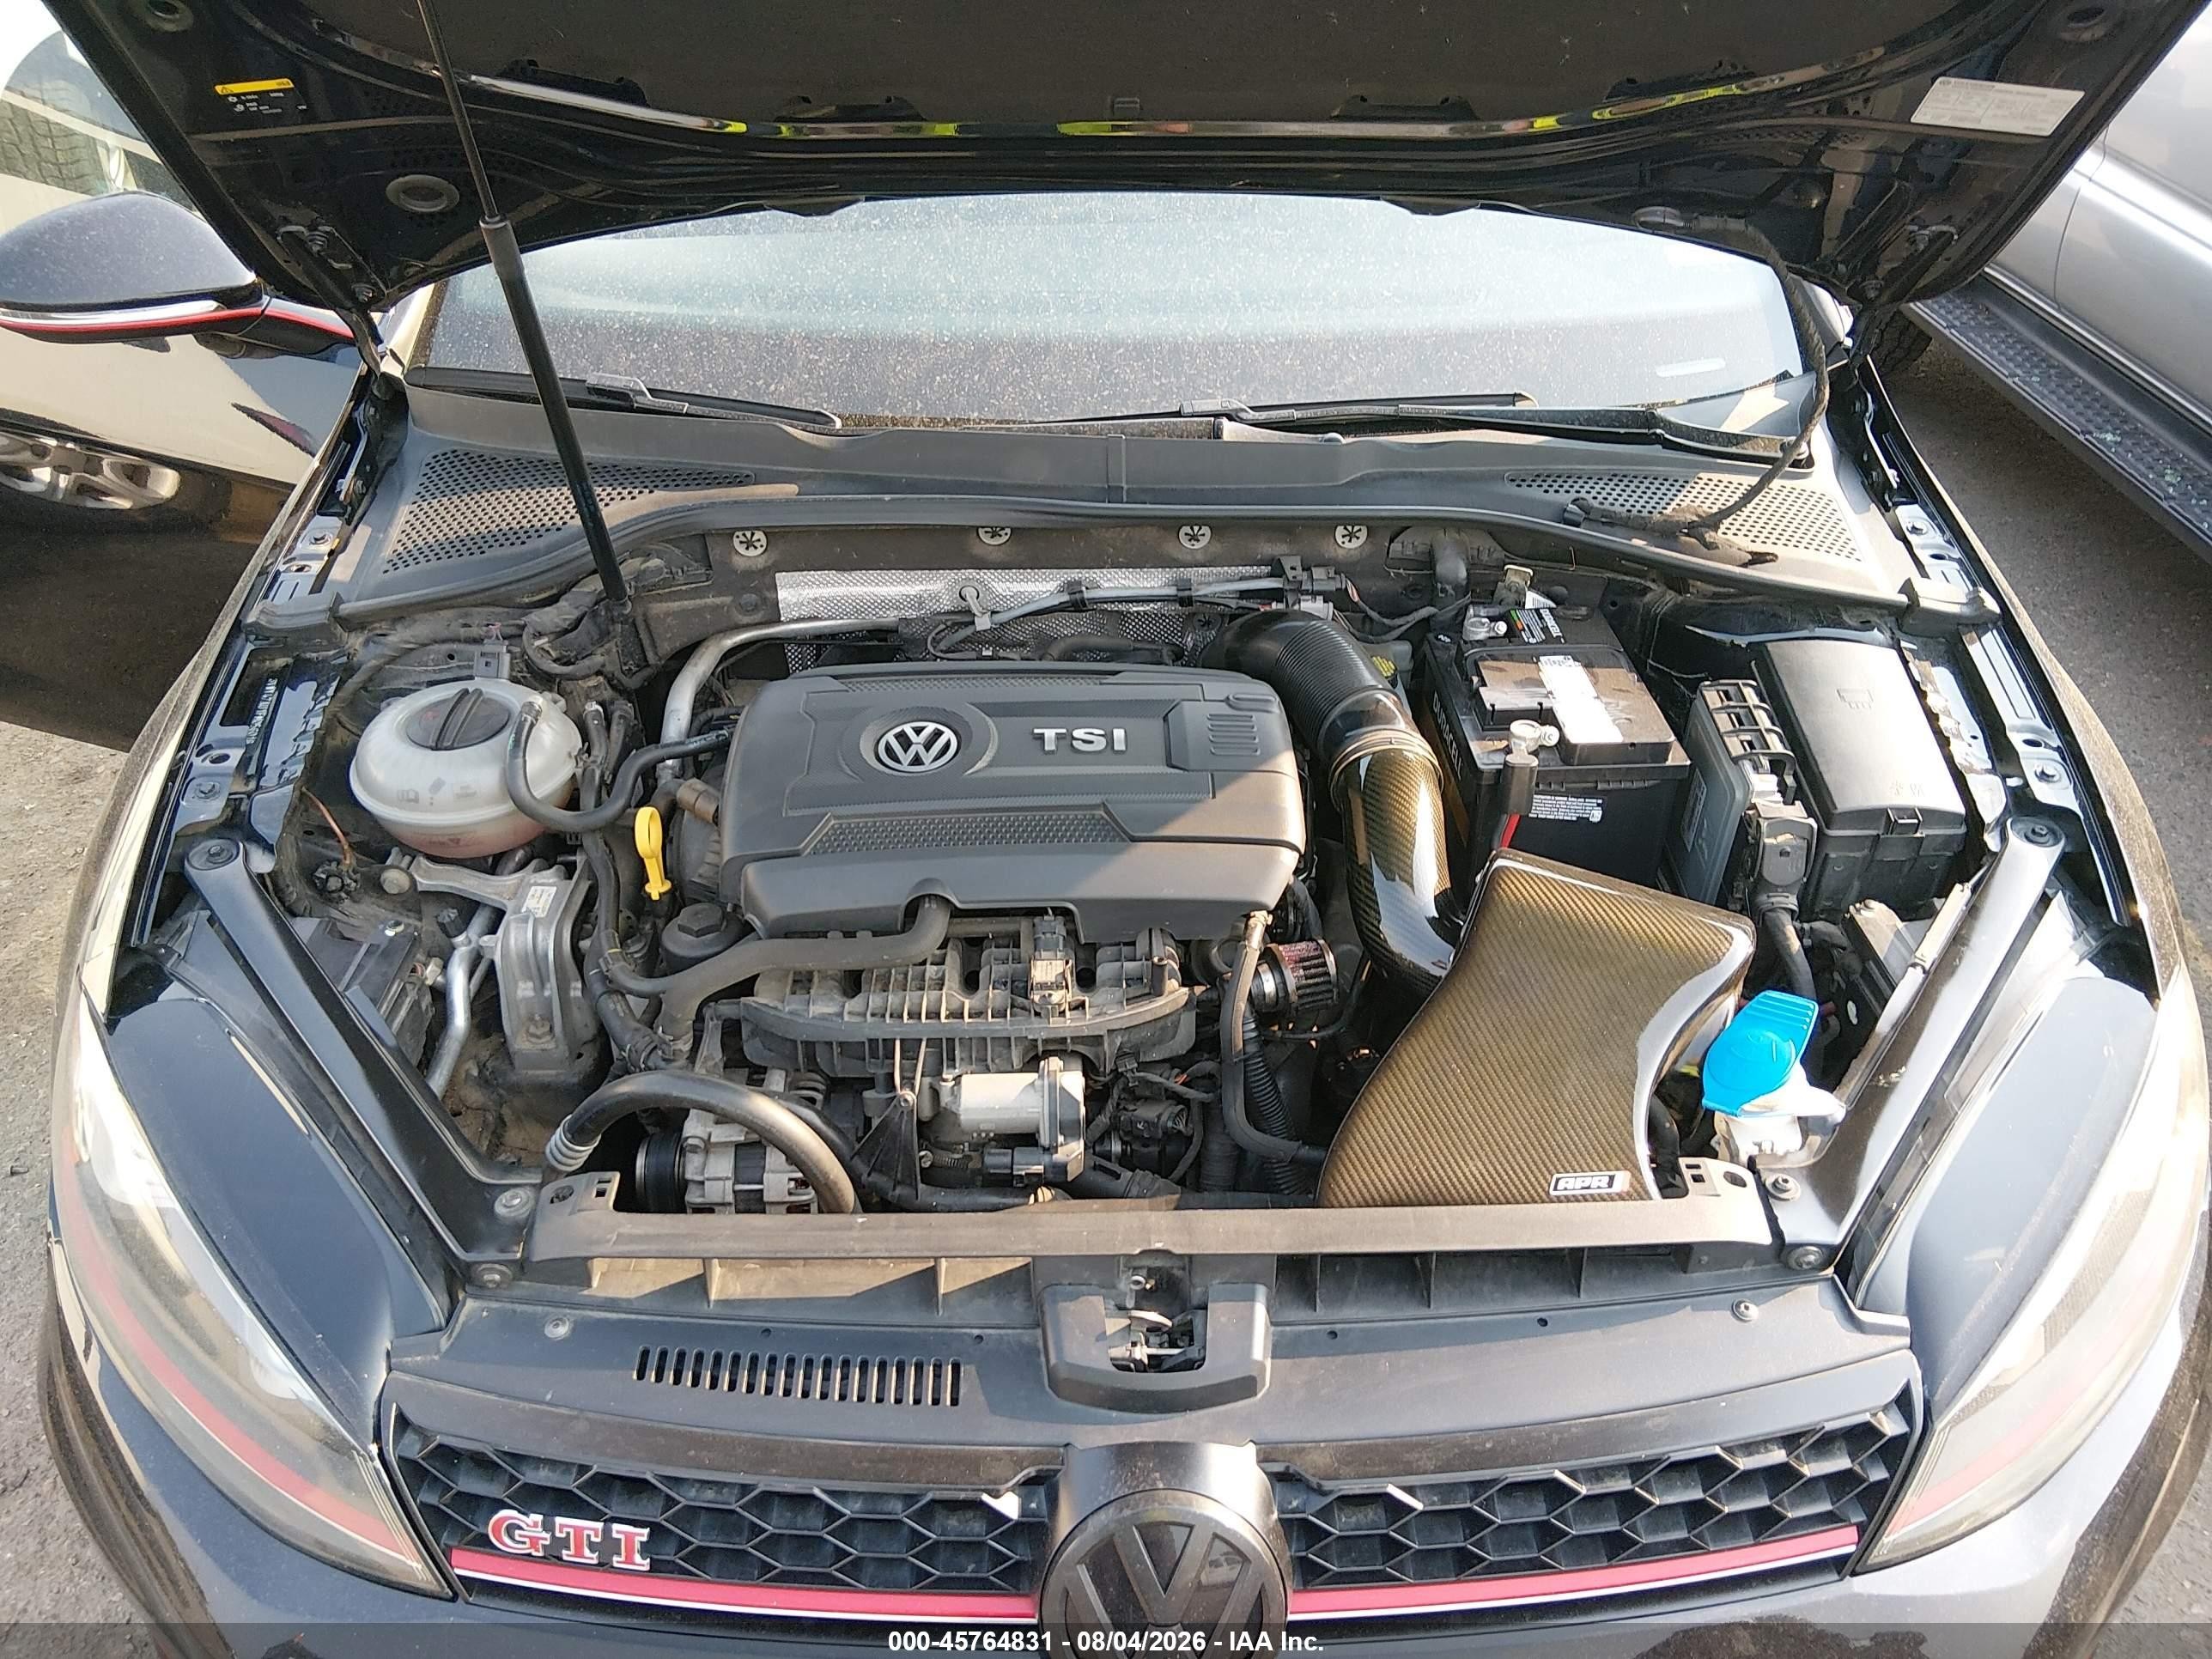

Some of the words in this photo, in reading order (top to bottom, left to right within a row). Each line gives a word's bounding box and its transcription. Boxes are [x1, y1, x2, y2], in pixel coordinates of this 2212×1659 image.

[1032, 727, 1127, 752] TSI
[1432, 690, 1462, 781] DURACELL
[1556, 1175, 1611, 1191] APR
[488, 1509, 651, 1571] GTI
